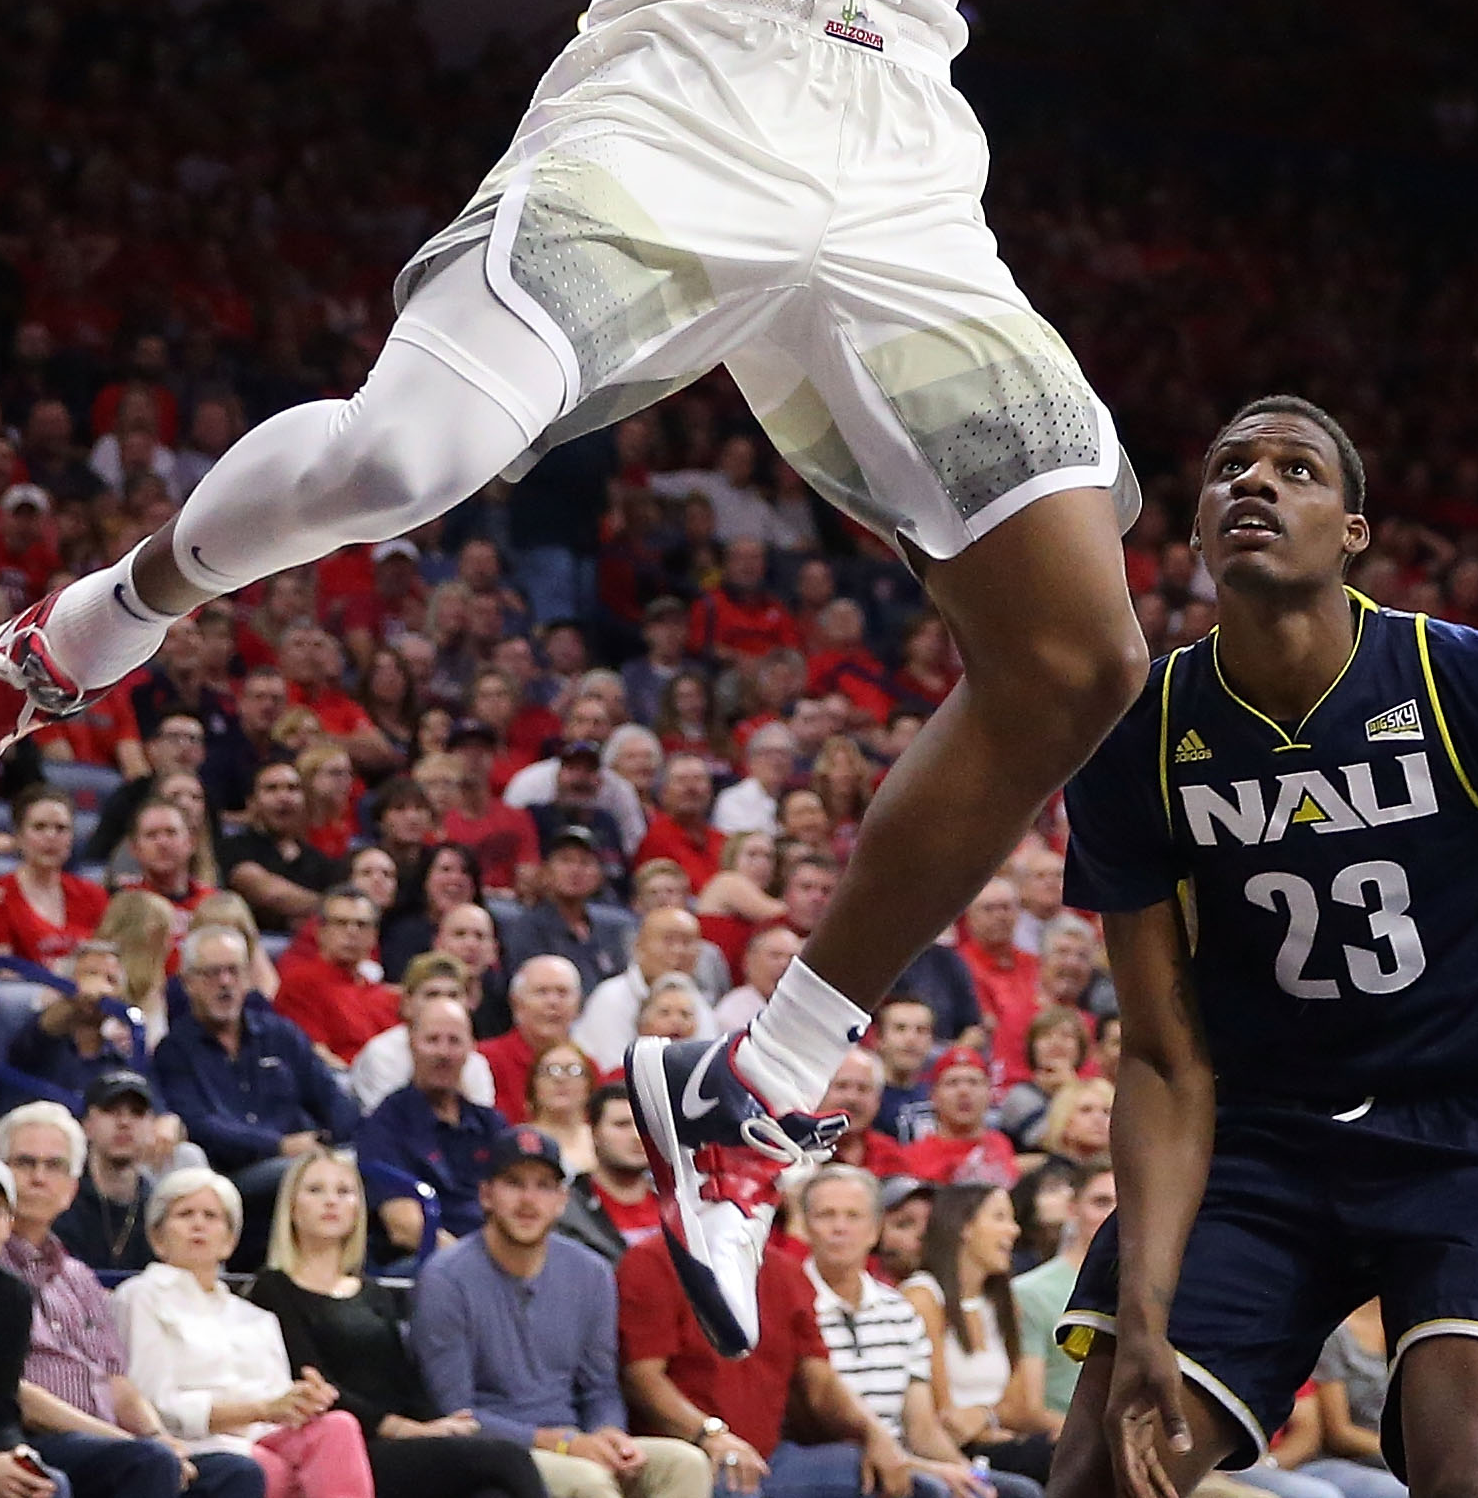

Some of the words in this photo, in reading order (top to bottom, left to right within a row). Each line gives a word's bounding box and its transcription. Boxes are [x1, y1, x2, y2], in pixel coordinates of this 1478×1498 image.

[825, 20, 883, 49] ARIZONA
[1179, 752, 1439, 846] NAU
[1245, 859, 1427, 999] 23
